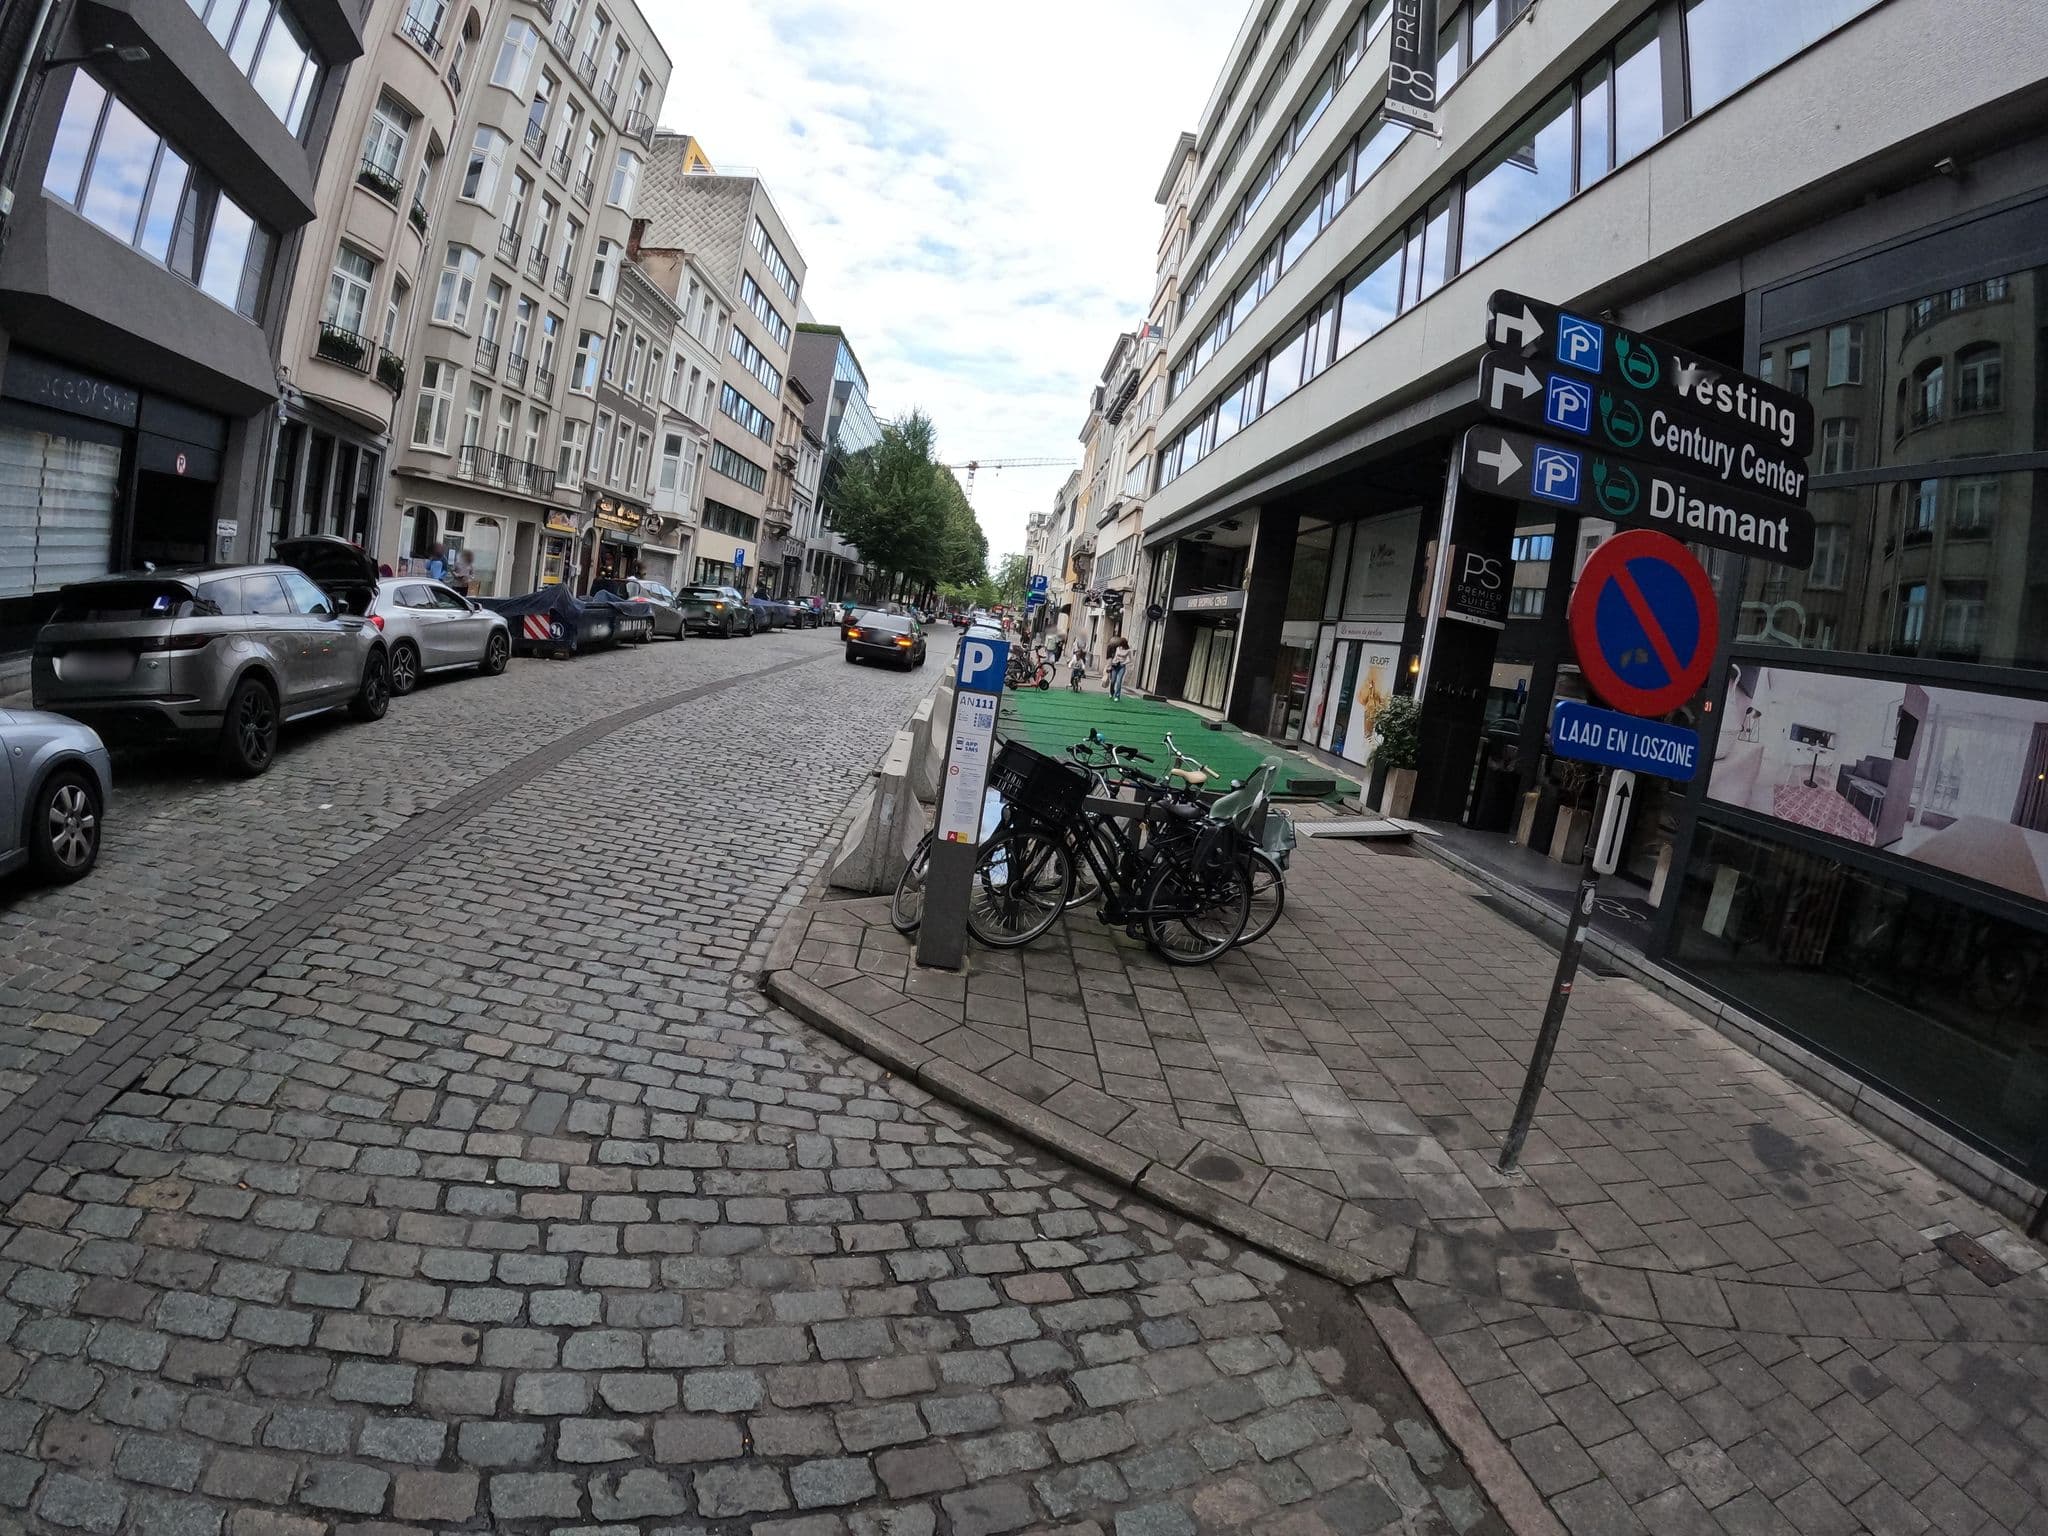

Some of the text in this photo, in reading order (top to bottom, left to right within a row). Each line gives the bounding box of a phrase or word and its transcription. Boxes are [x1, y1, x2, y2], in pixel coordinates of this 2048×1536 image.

[1395, 0, 1417, 52] PRE
[1388, 61, 1434, 102] PS
[1390, 102, 1429, 119] PLUS
[1673, 356, 1796, 447] Vesting
[1650, 410, 1804, 498] Century Center
[1650, 479, 1789, 552] Diamant
[1463, 553, 1503, 589] PS
[961, 641, 994, 683] P
[1559, 718, 1695, 767] LAAD EN LOSZONE
